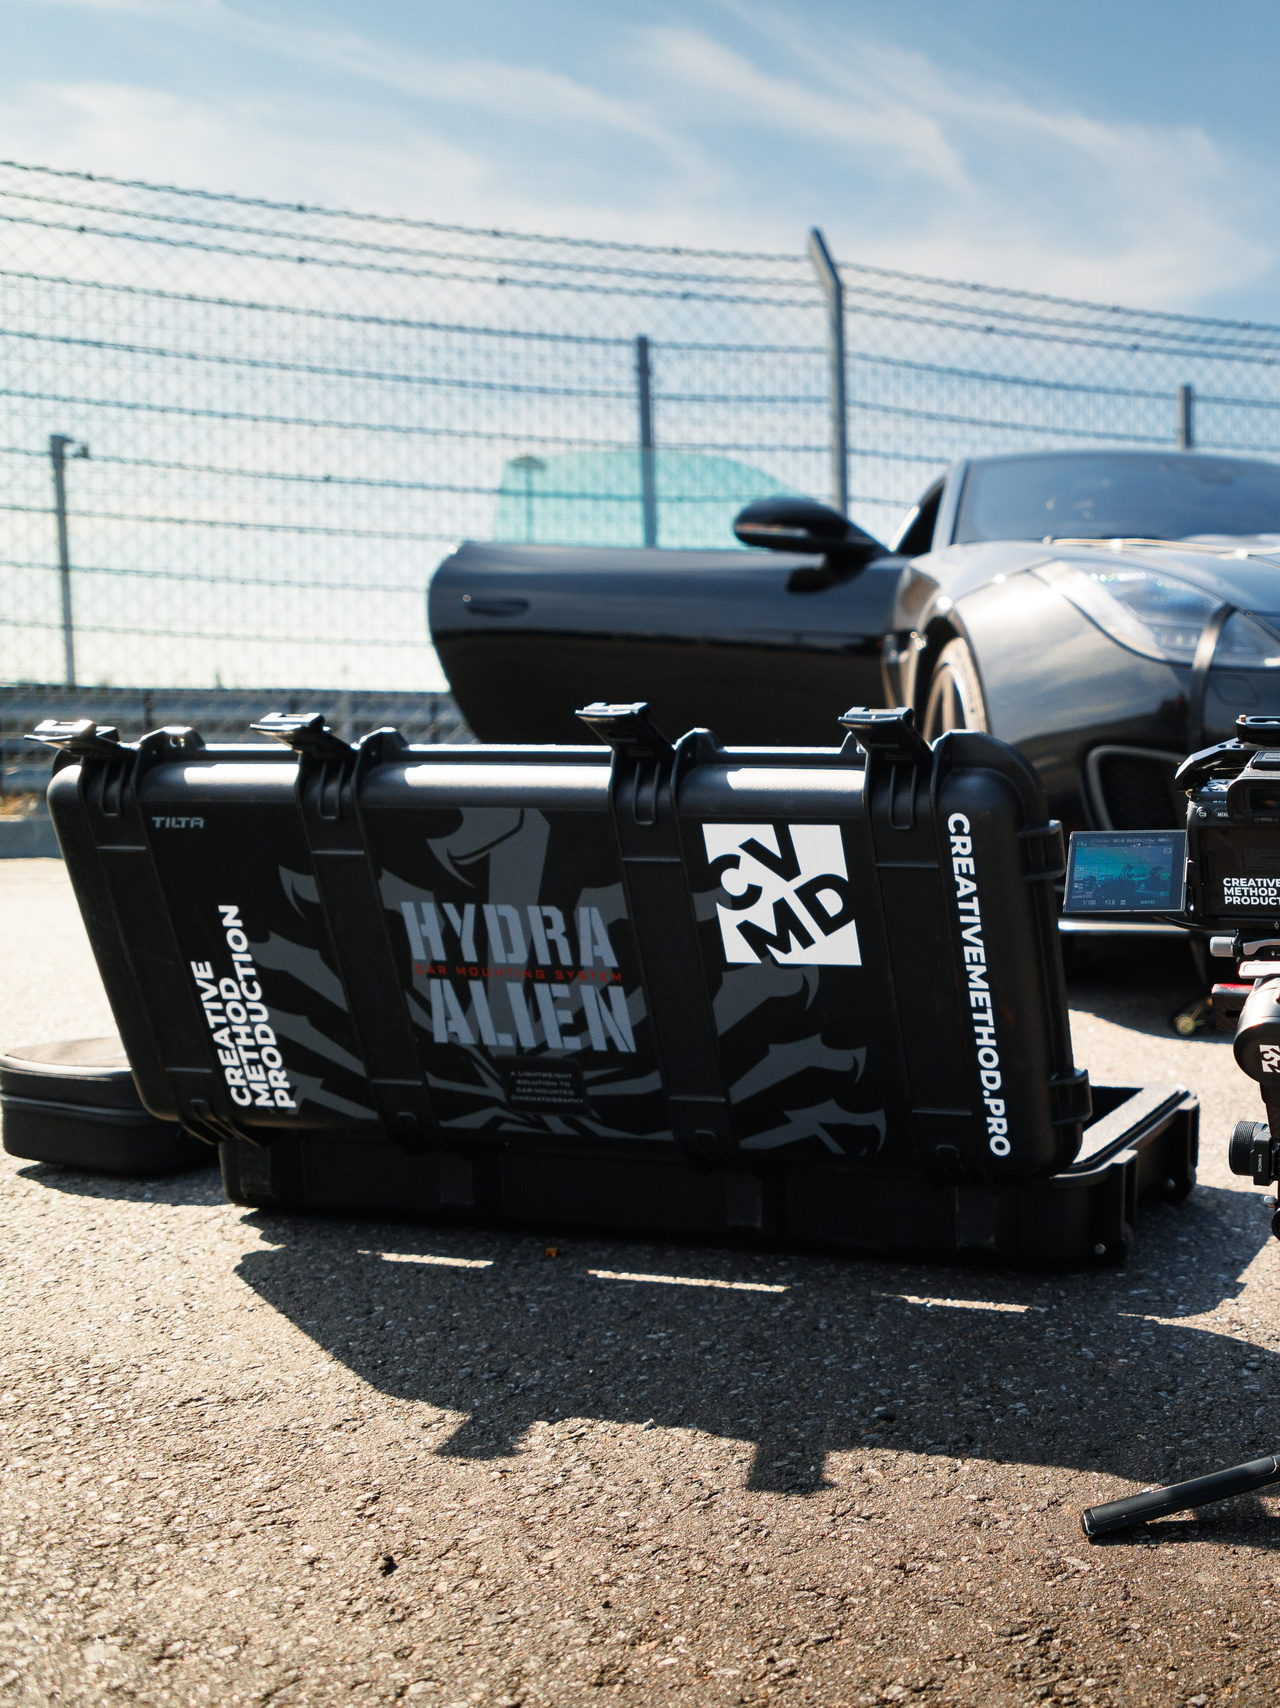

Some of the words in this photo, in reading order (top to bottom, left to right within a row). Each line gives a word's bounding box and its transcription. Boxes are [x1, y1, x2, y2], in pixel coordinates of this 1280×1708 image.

[152, 816, 205, 829] TILTA
[1223, 886, 1278, 897] METHOD
[401, 902, 619, 967] HYDRA
[217, 905, 297, 1108] PRODUCTION
[415, 964, 447, 976] CAR
[456, 966, 546, 980] MOUNTING
[555, 970, 623, 981] SYSTEM
[947, 812, 1011, 1156] CREATIVEMETHOD.PRO
[190, 961, 253, 1107] CREATIVE
[218, 977, 275, 1107] METHOD
[429, 978, 637, 1053] ALIEN
